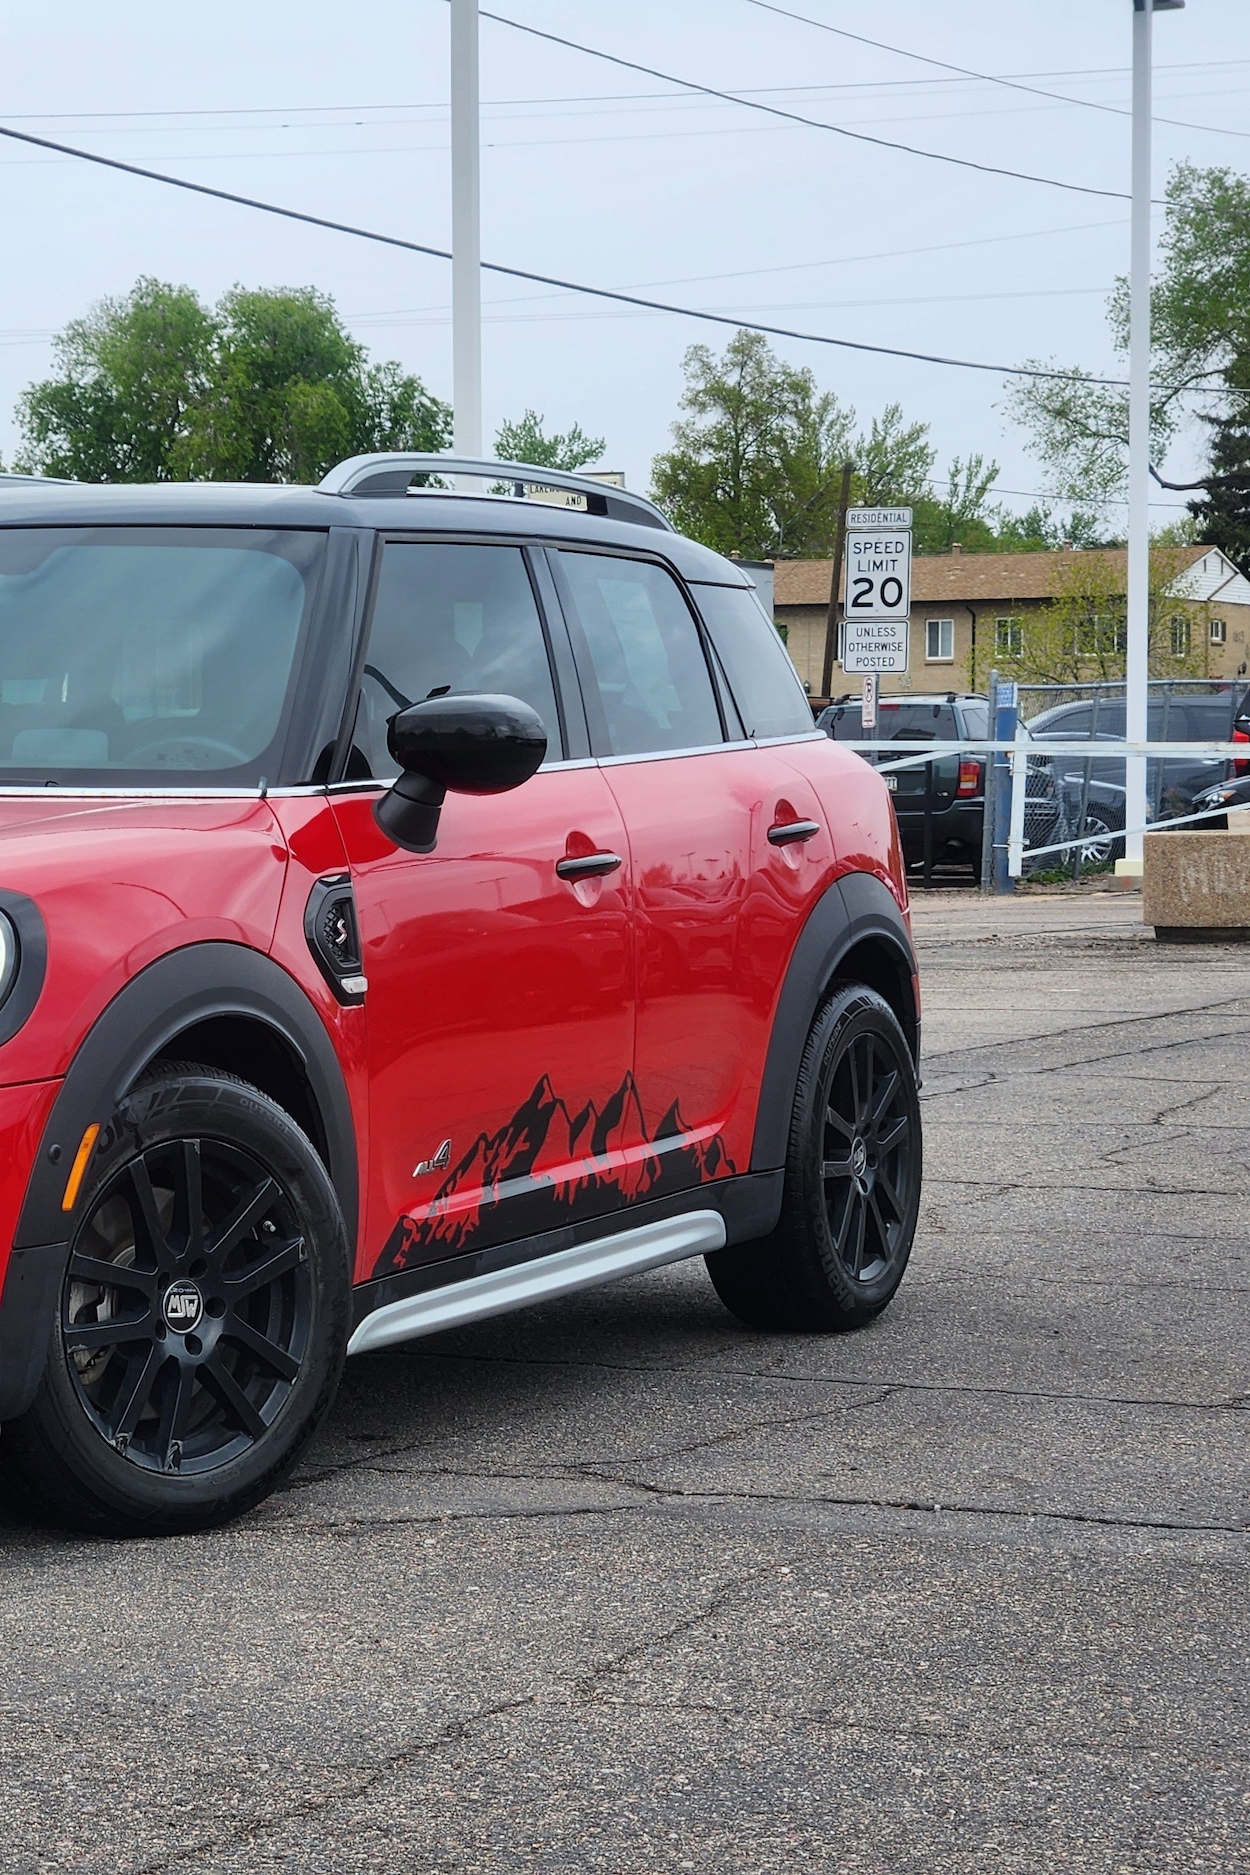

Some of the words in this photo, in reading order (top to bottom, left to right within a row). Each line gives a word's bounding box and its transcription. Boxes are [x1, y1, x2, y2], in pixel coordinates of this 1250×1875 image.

[850, 513, 907, 523] RESIDENTIAL
[853, 541, 904, 555] SPEED
[857, 559, 898, 572] LIMIT
[851, 577, 903, 608] 20
[856, 627, 896, 637] UNLESS
[849, 641, 903, 652] OTHERWISE
[856, 657, 895, 667] POSTED
